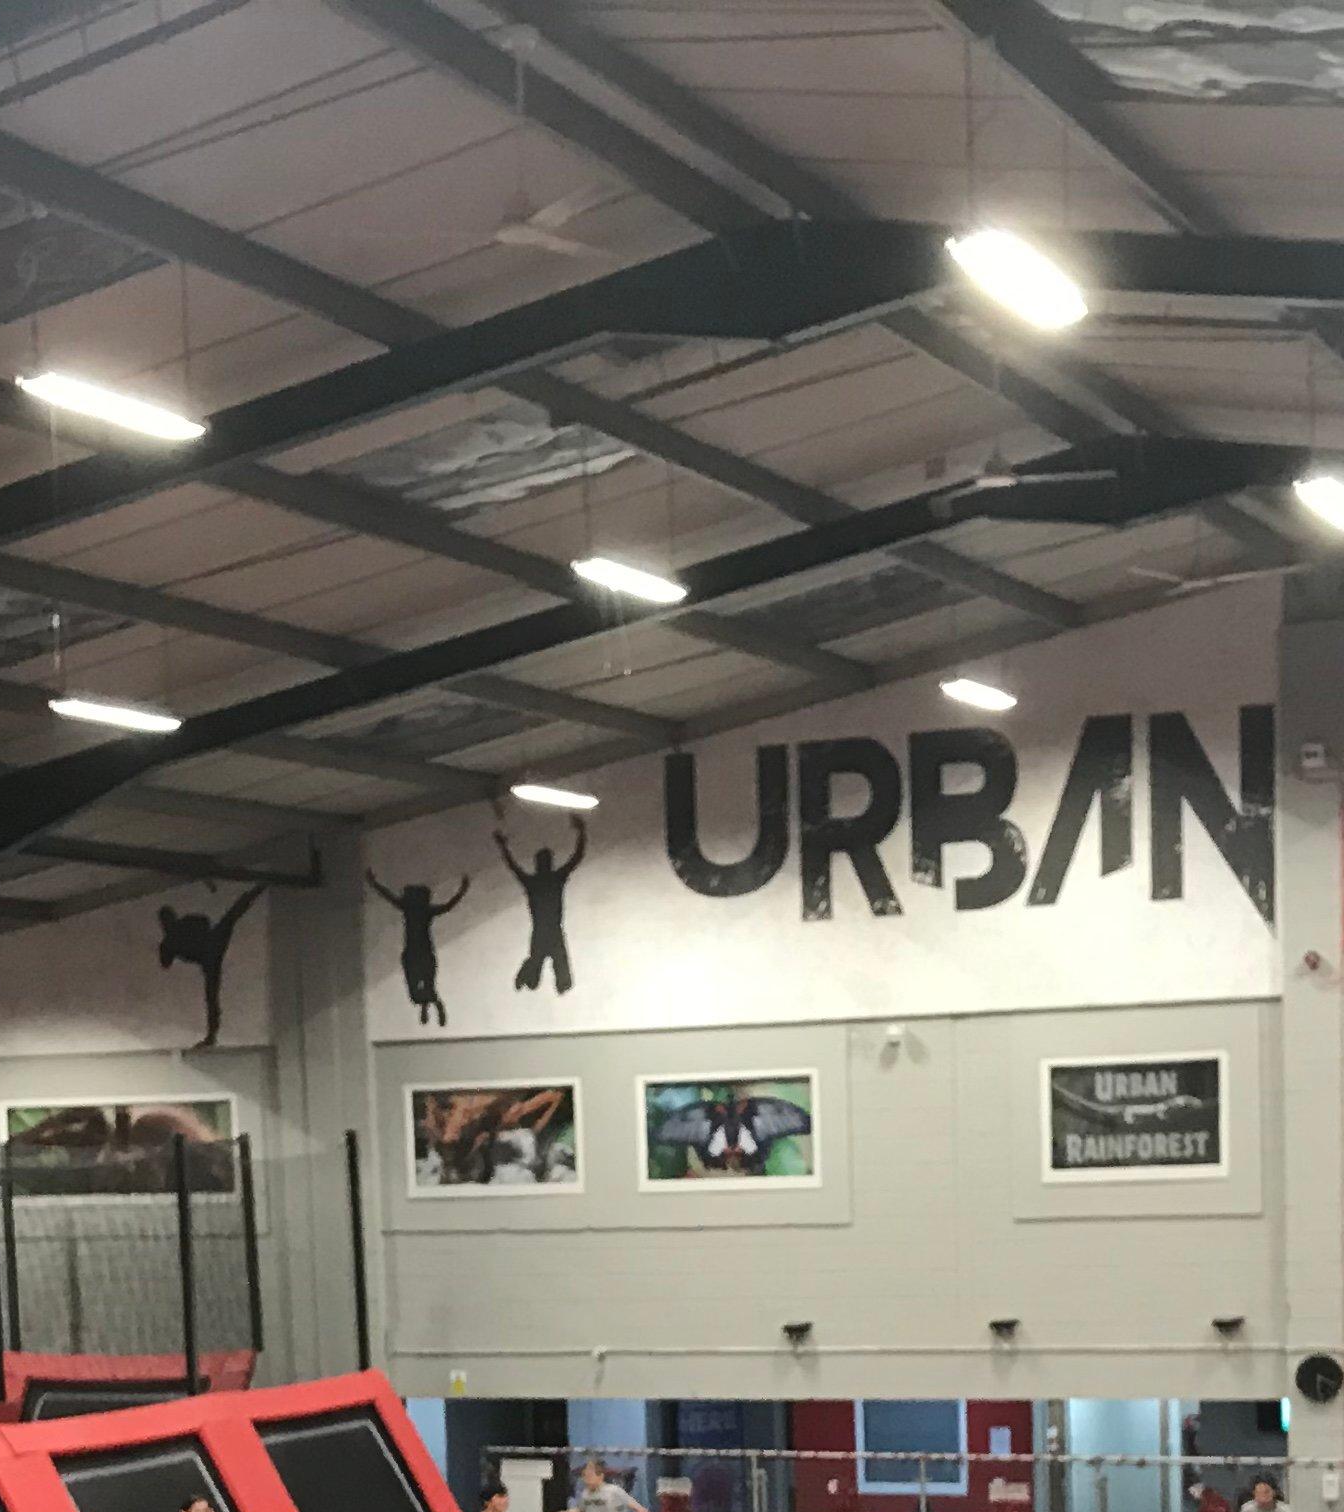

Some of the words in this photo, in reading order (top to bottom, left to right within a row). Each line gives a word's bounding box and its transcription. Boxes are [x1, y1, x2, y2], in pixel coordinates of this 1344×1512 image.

[664, 704, 1277, 936] URBAN
[1093, 1069, 1179, 1102] URBAN
[1065, 1130, 1211, 1165] RAINFOREST
